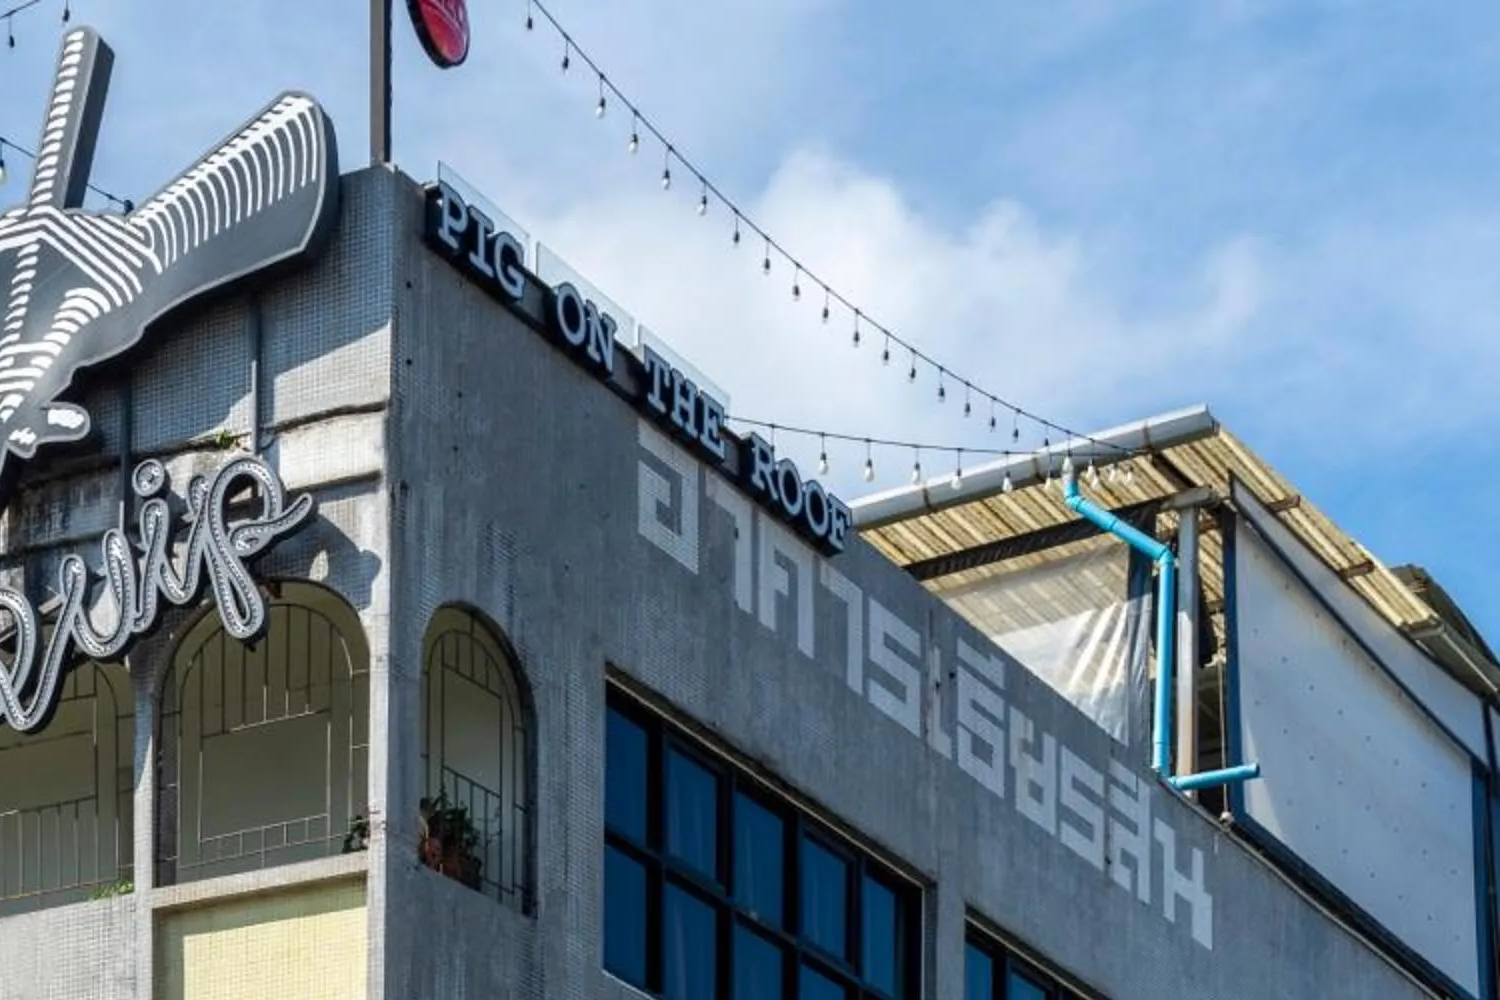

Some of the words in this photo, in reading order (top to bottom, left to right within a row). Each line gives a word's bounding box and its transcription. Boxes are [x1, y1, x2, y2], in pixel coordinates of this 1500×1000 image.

[438, 181, 524, 299] PIG
[557, 283, 616, 372] ON
[643, 345, 725, 457] THE
[751, 433, 851, 550] ROOF
